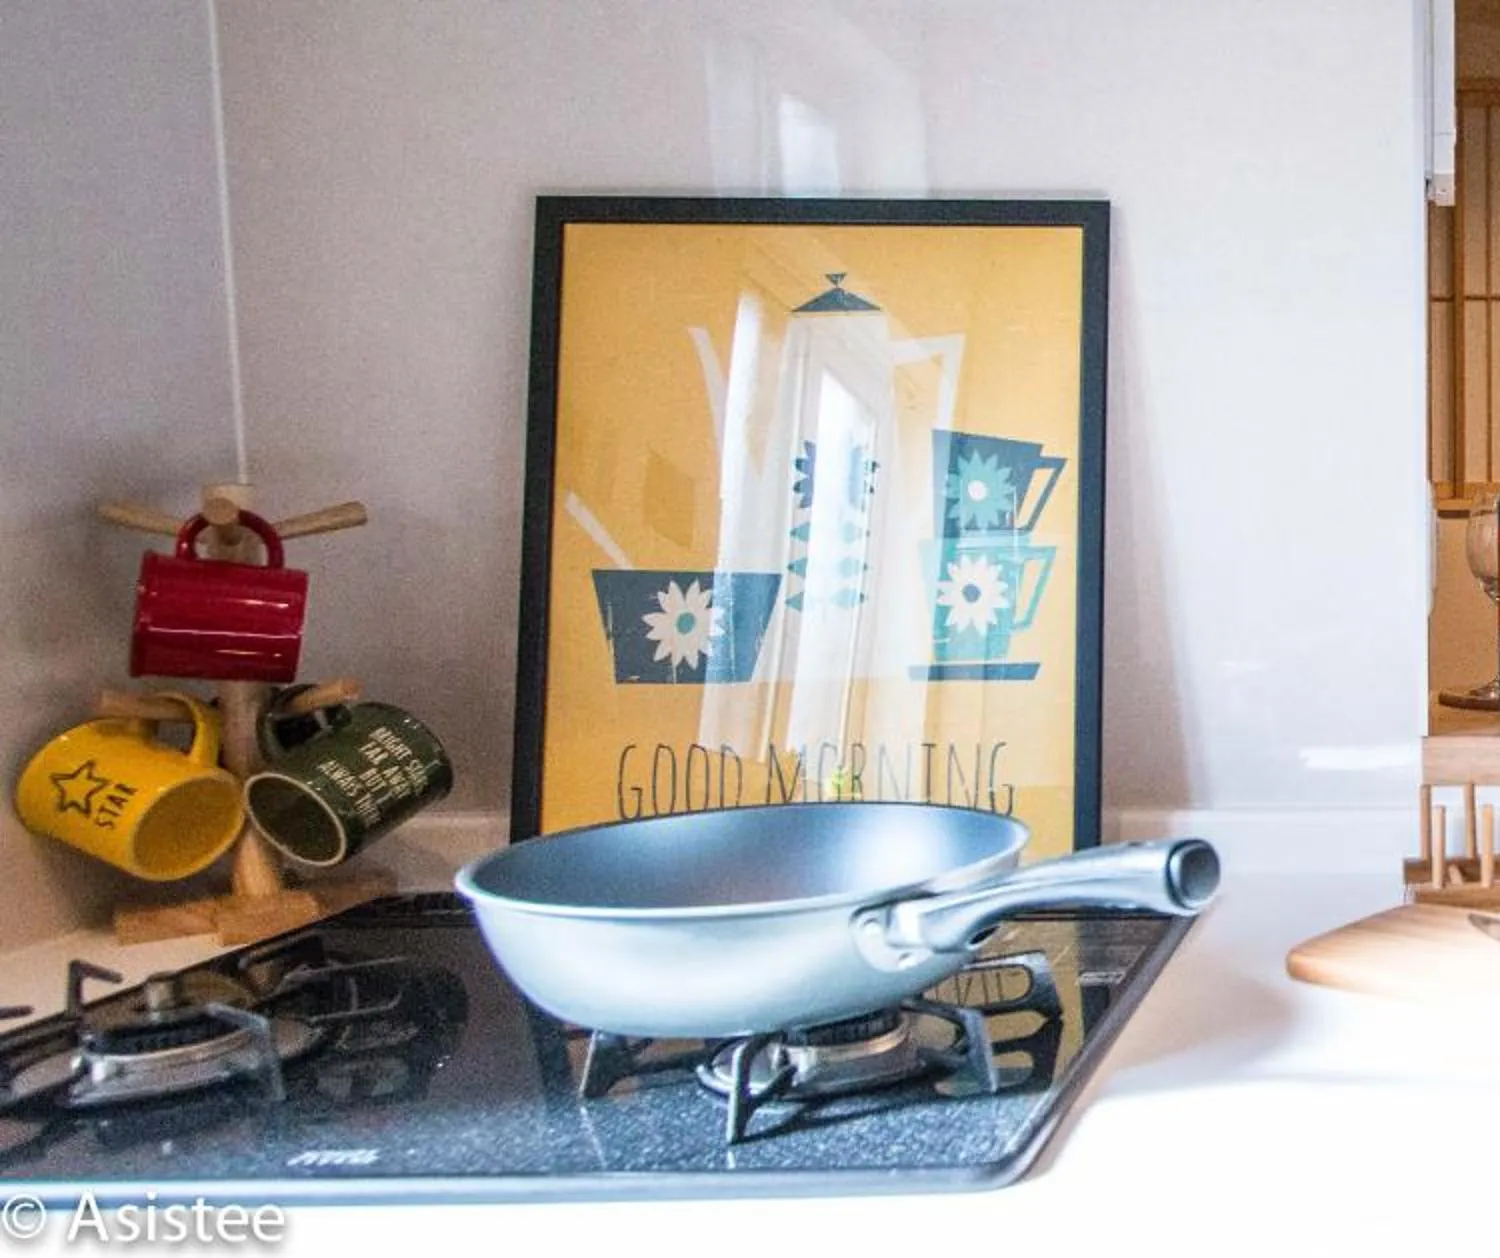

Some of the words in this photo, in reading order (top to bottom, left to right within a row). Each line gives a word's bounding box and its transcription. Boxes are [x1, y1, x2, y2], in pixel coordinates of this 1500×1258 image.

[358, 740, 389, 765] FAR
[358, 767, 387, 793] BUT
[618, 743, 742, 821] GOOD
[766, 741, 1015, 817] MORNING
[94, 783, 139, 829] STAR
